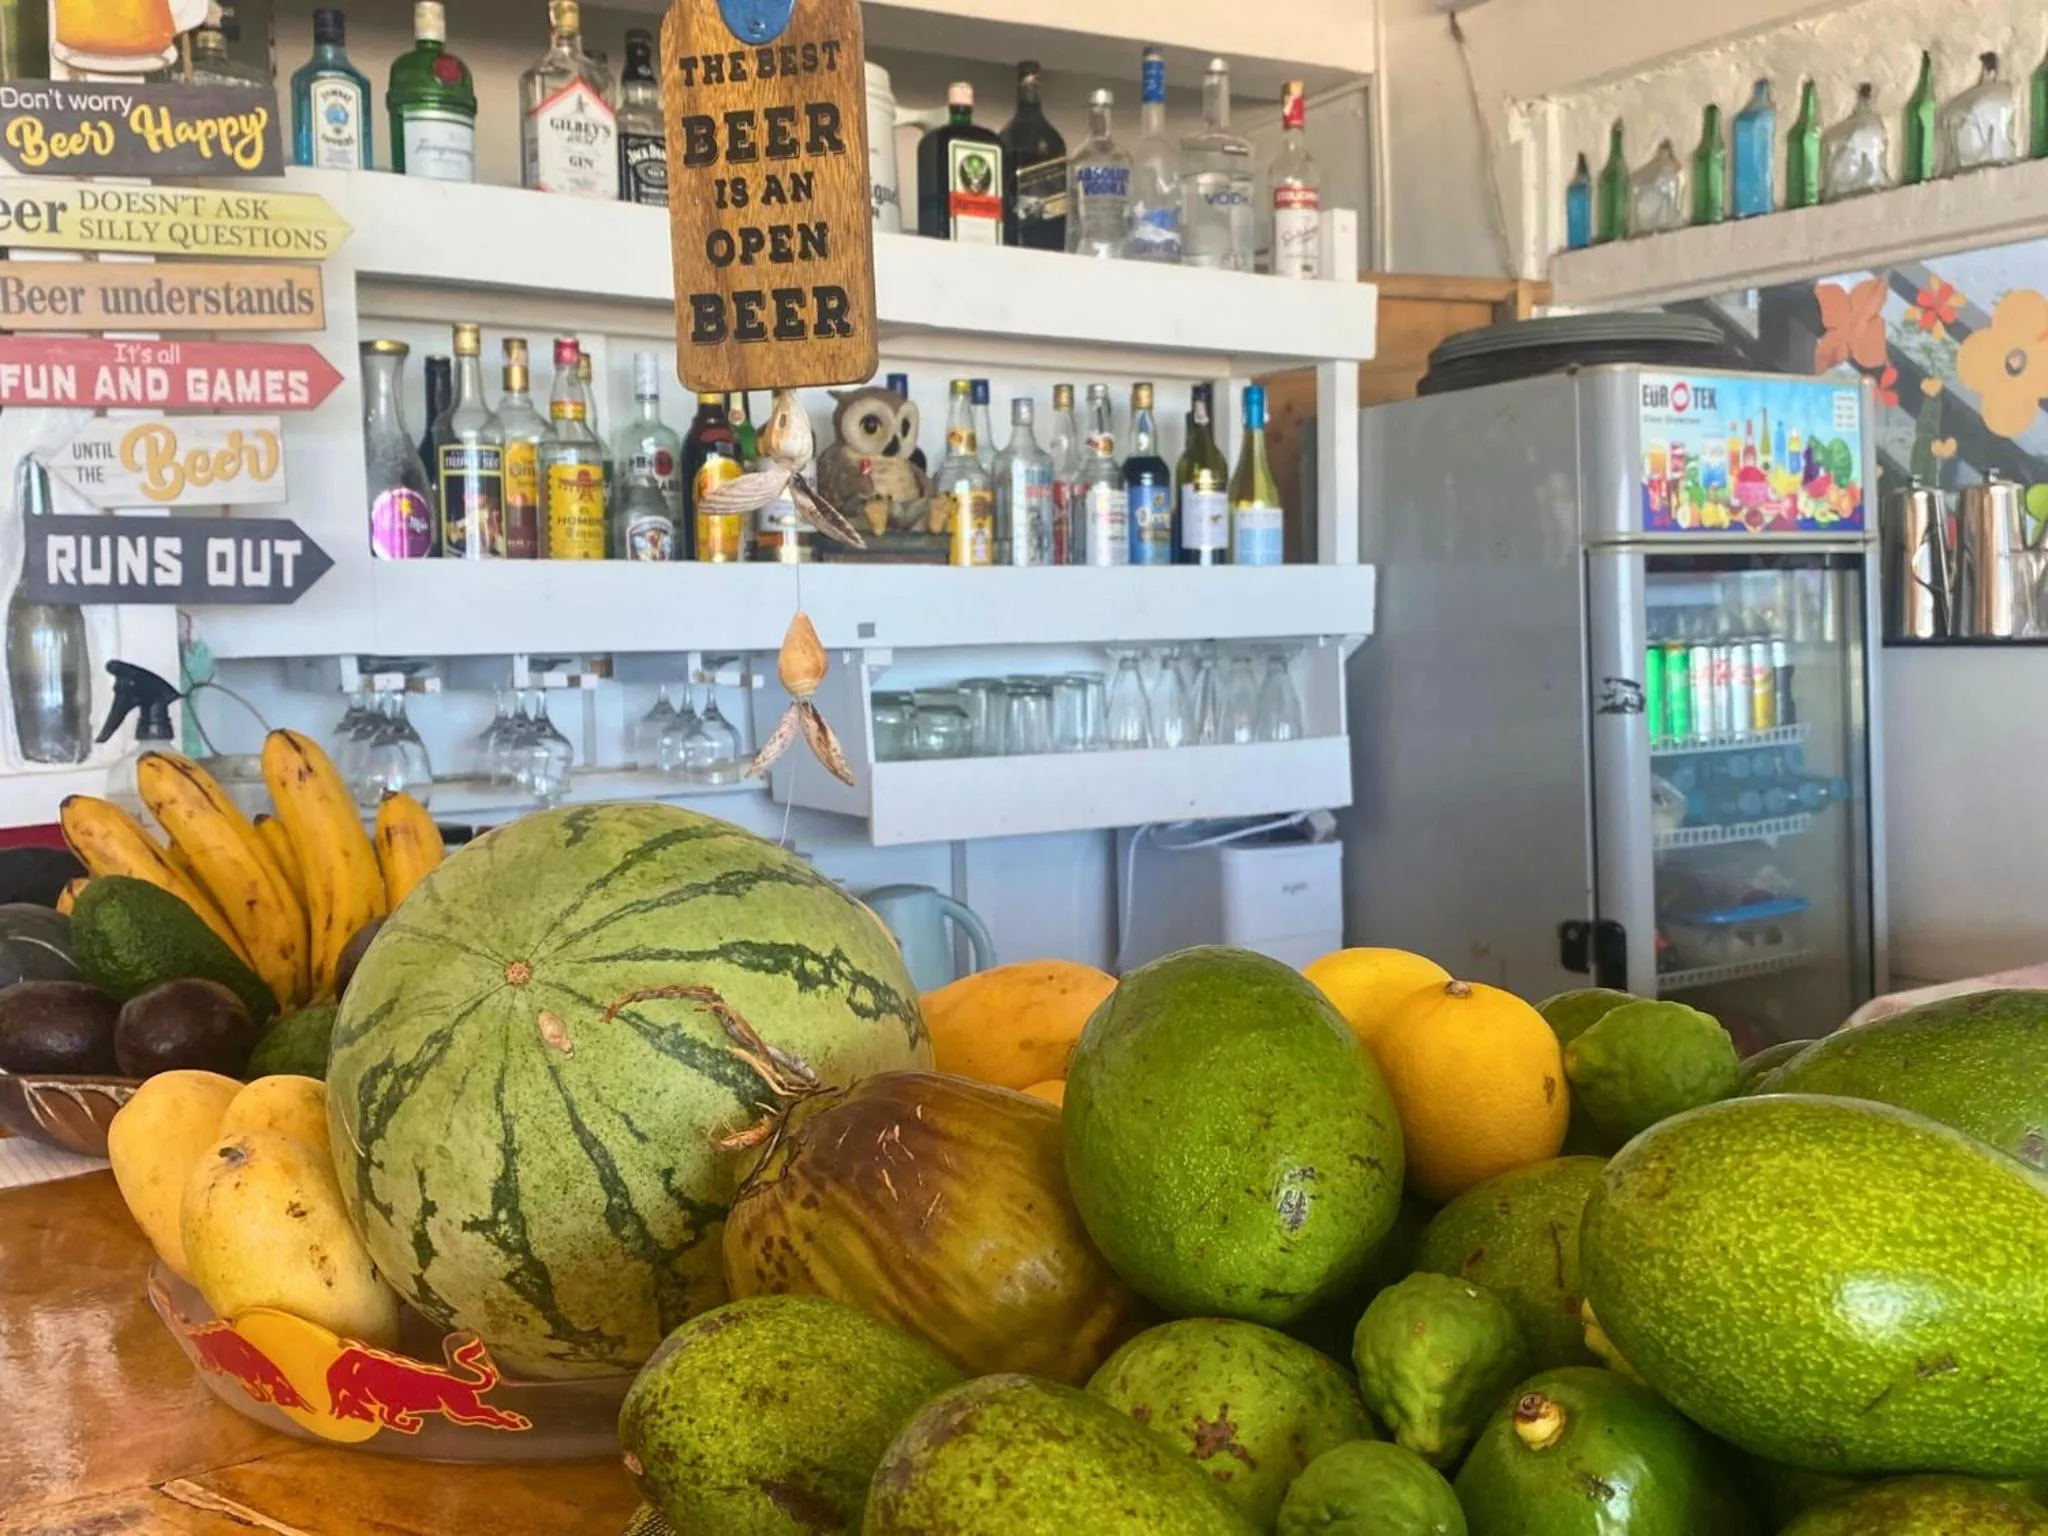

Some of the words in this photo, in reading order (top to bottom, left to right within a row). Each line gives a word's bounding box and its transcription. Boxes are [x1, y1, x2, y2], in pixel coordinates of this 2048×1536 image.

[679, 51, 747, 87] THE
[756, 40, 841, 79] BEST
[1, 87, 62, 109] Don't
[69, 94, 132, 117] worry
[6, 116, 115, 167] Beer
[129, 104, 267, 170] Happy
[550, 117, 611, 137] GILBEY'S
[681, 102, 846, 168] BEER
[569, 156, 595, 169] GIN
[78, 189, 204, 218] DOESN'T
[216, 199, 270, 220] ASK
[715, 176, 749, 209] IS
[761, 171, 815, 205] AN
[79, 219, 158, 243] SILLY
[169, 223, 328, 250] QUESTIONS
[706, 221, 829, 268] OPEN
[0, 275, 85, 315] Beer
[99, 278, 314, 316] understands
[690, 285, 853, 346] BEER
[114, 343, 152, 363] It's
[157, 345, 181, 364] all
[0, 363, 77, 399] FUN
[94, 365, 170, 402] AND
[186, 368, 309, 404] GAMES
[72, 442, 116, 460] UNTIL
[120, 422, 279, 502] Beer
[76, 466, 105, 483] THE
[47, 534, 183, 587] RUNS
[207, 537, 301, 588] OUT
